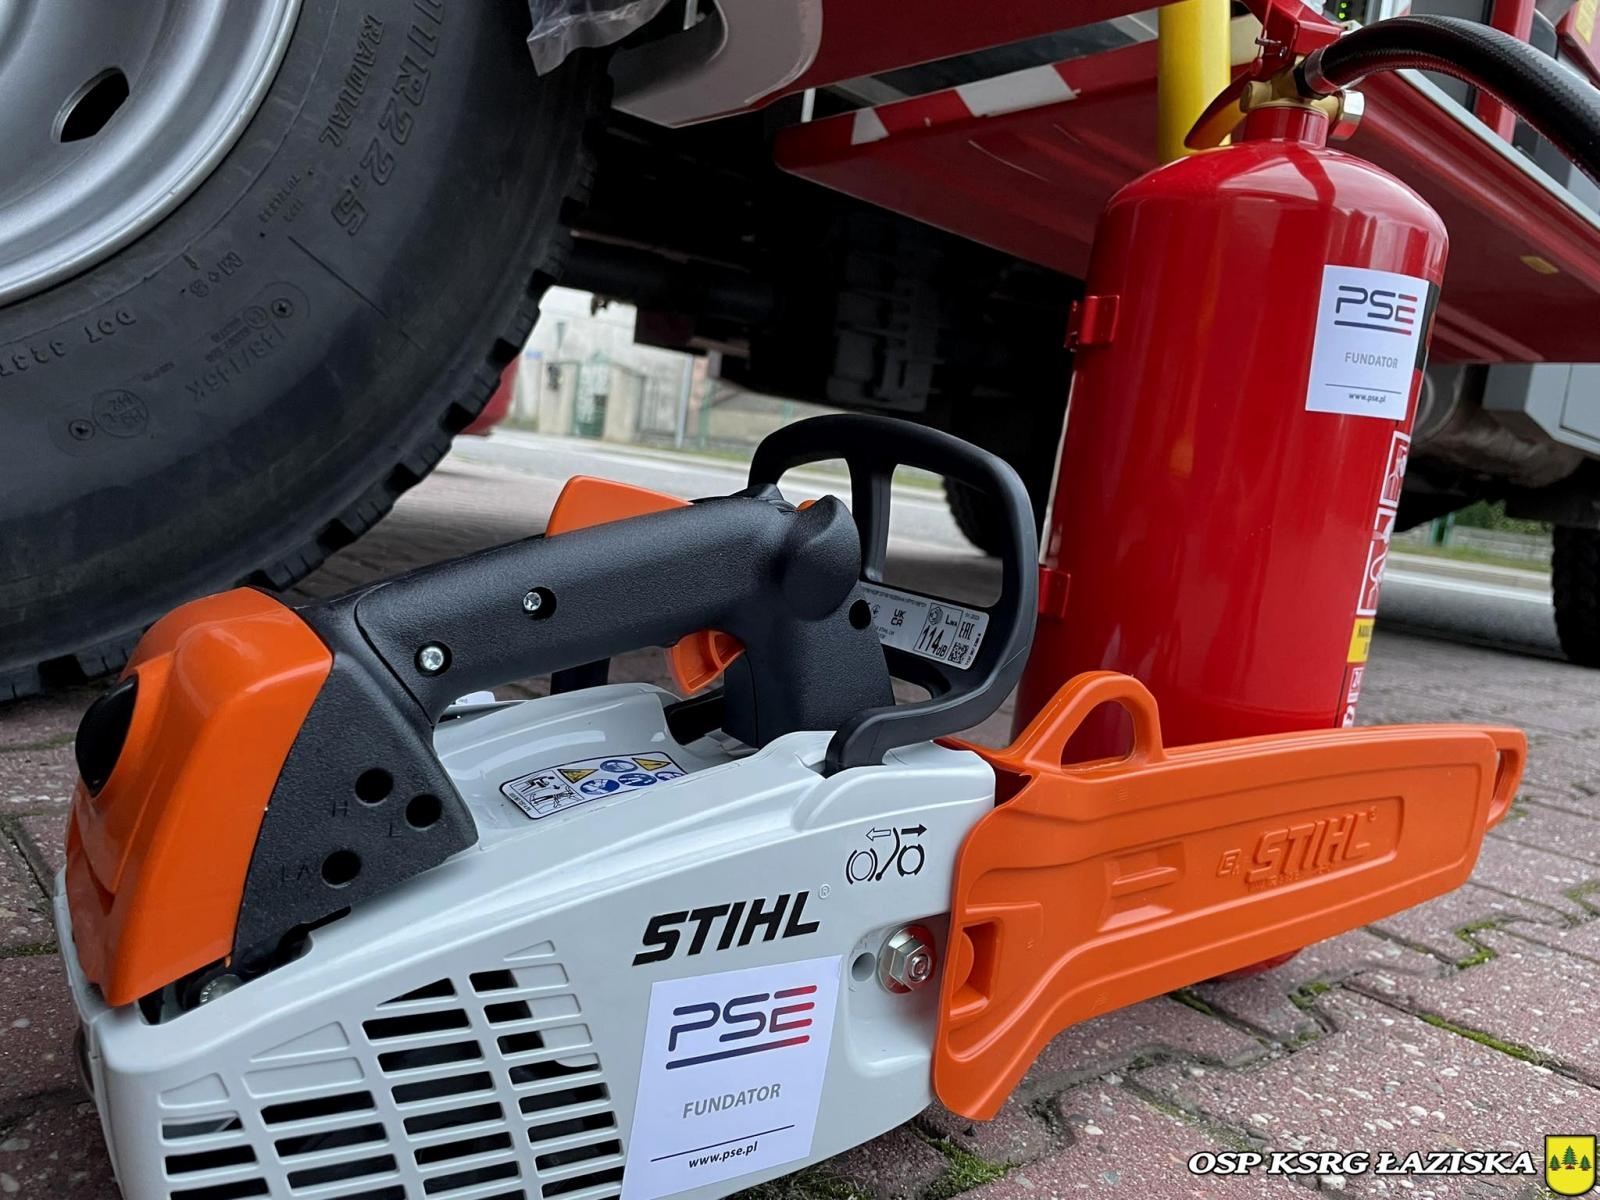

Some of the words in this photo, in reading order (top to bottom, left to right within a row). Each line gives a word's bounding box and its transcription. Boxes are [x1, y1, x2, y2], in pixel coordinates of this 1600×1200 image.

[318, 14, 385, 147] RADIAL
[1335, 285, 1418, 324] PSE
[83, 310, 137, 344] DOT
[1344, 352, 1399, 369] FUNDATOR
[1348, 392, 1387, 404] www.pse.pl
[331, 800, 348, 818] H
[389, 821, 403, 838] L
[1246, 811, 1371, 883] STIHL
[632, 890, 821, 967] STIHL
[668, 984, 818, 1052] PSE
[682, 1083, 782, 1119] FUNDATOR
[688, 1141, 758, 1168] www.pse.pl
